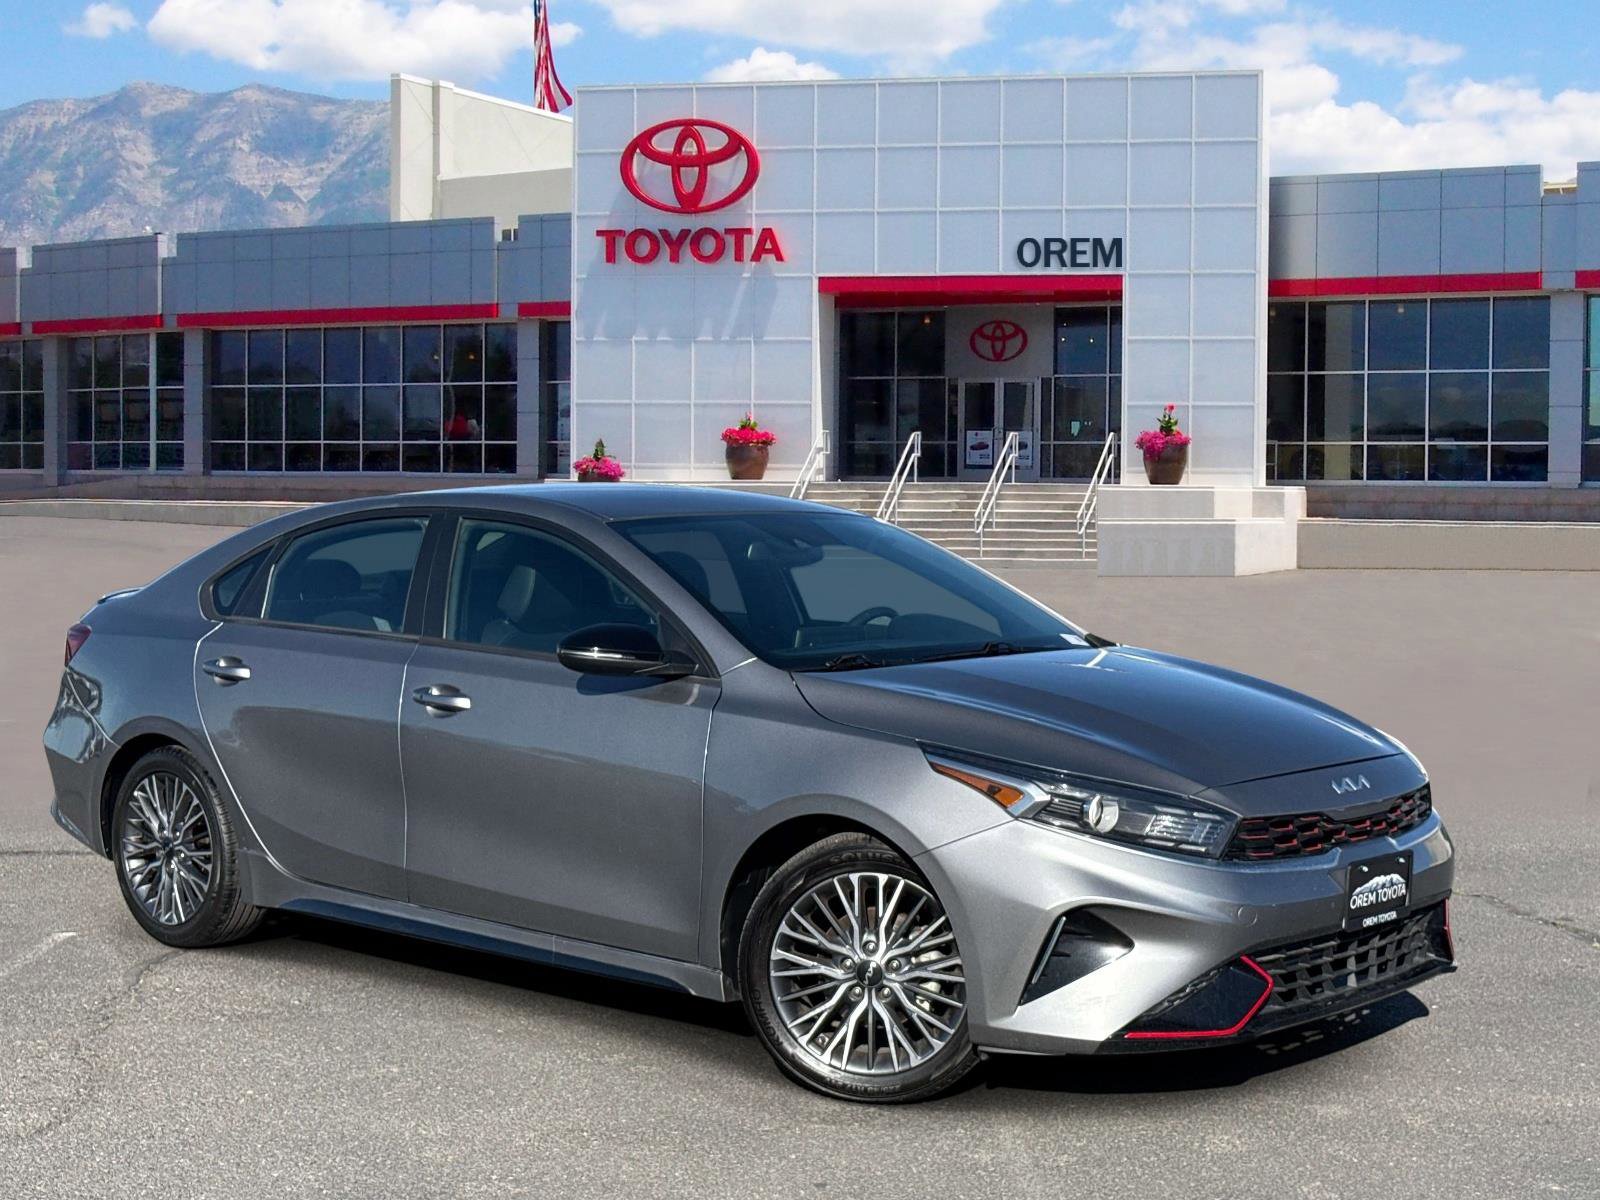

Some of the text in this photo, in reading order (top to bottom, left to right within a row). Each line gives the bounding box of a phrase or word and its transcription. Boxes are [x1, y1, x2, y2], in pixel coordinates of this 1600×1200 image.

[596, 227, 784, 264] TOYOTA
[1017, 238, 1122, 267] OREM
[1331, 774, 1371, 794] KIA
[1350, 883, 1406, 909] OREM TOYOTA
[1362, 911, 1397, 927] OREM TOYOTA
